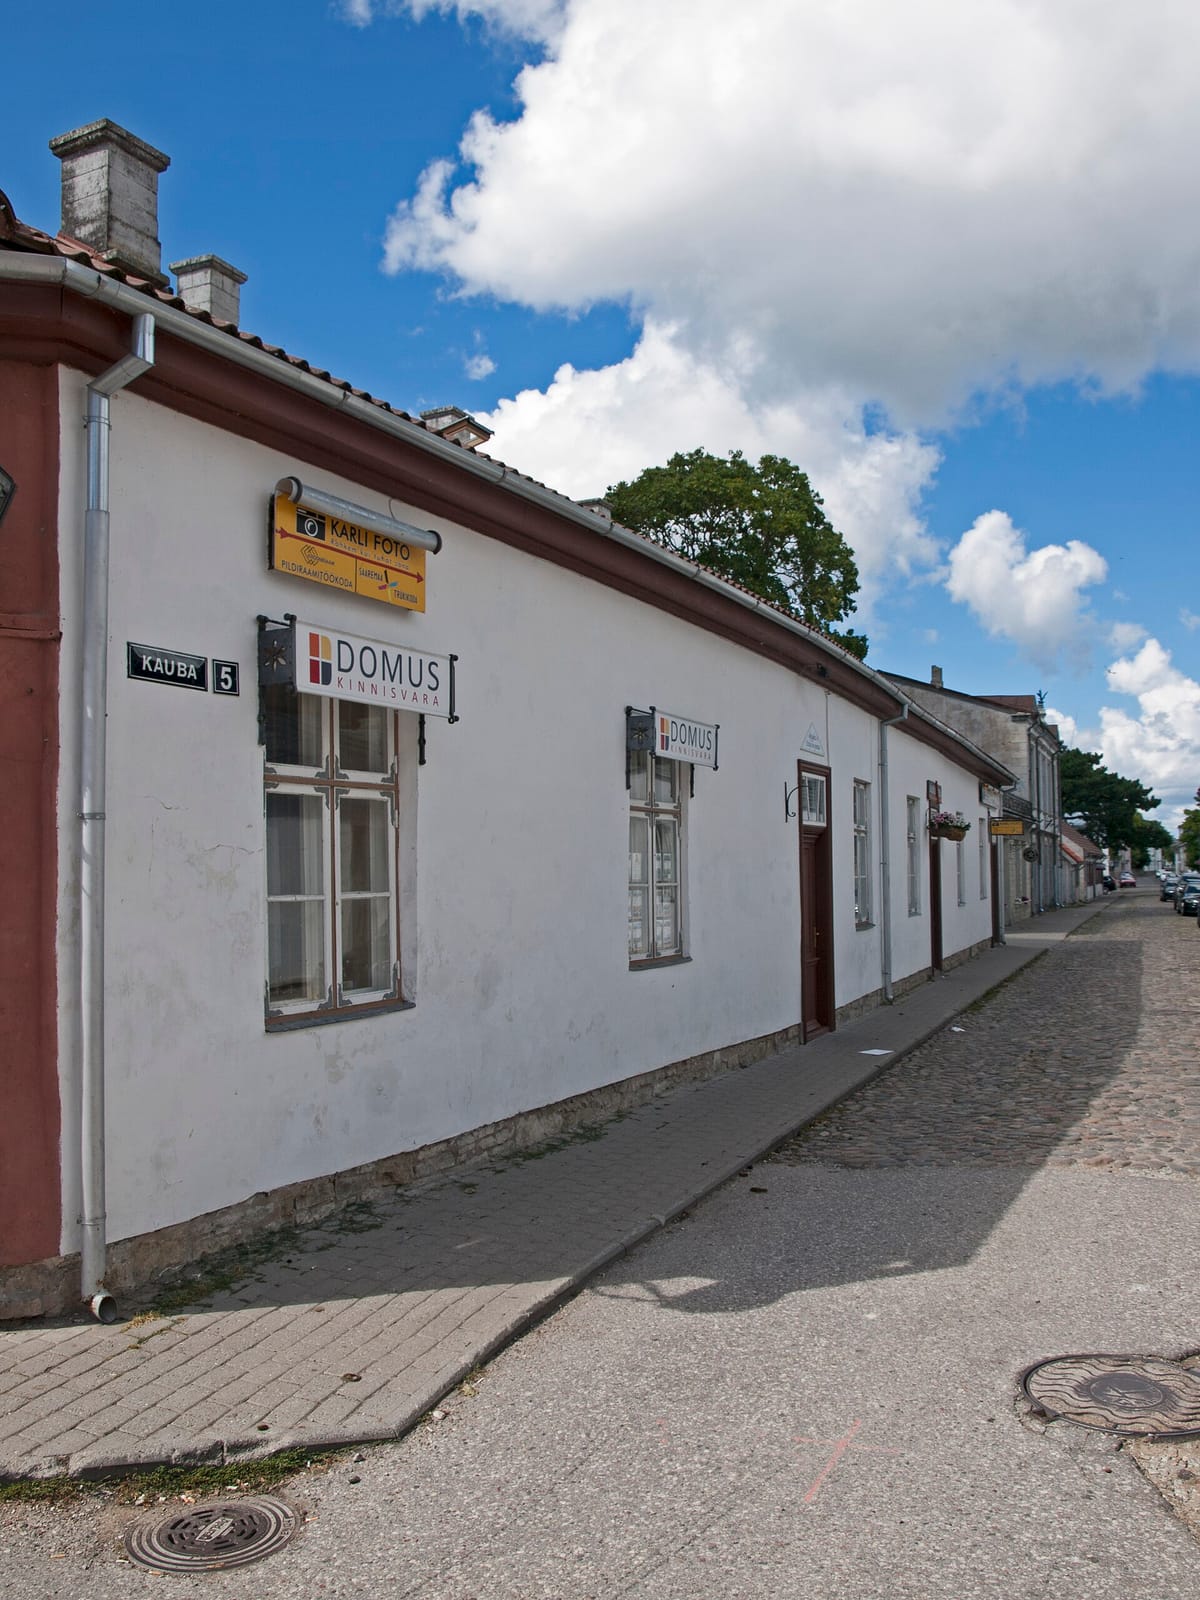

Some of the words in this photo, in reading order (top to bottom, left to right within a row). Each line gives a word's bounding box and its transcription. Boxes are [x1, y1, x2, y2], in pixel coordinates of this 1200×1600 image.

[331, 519, 368, 548] KARLI
[373, 534, 410, 561] FOTO
[142, 654, 198, 680] KAUBA
[220, 666, 233, 690] 5
[337, 639, 440, 691] DOMUS
[337, 676, 440, 707] KINNISVARA
[671, 720, 712, 751] DOMUS
